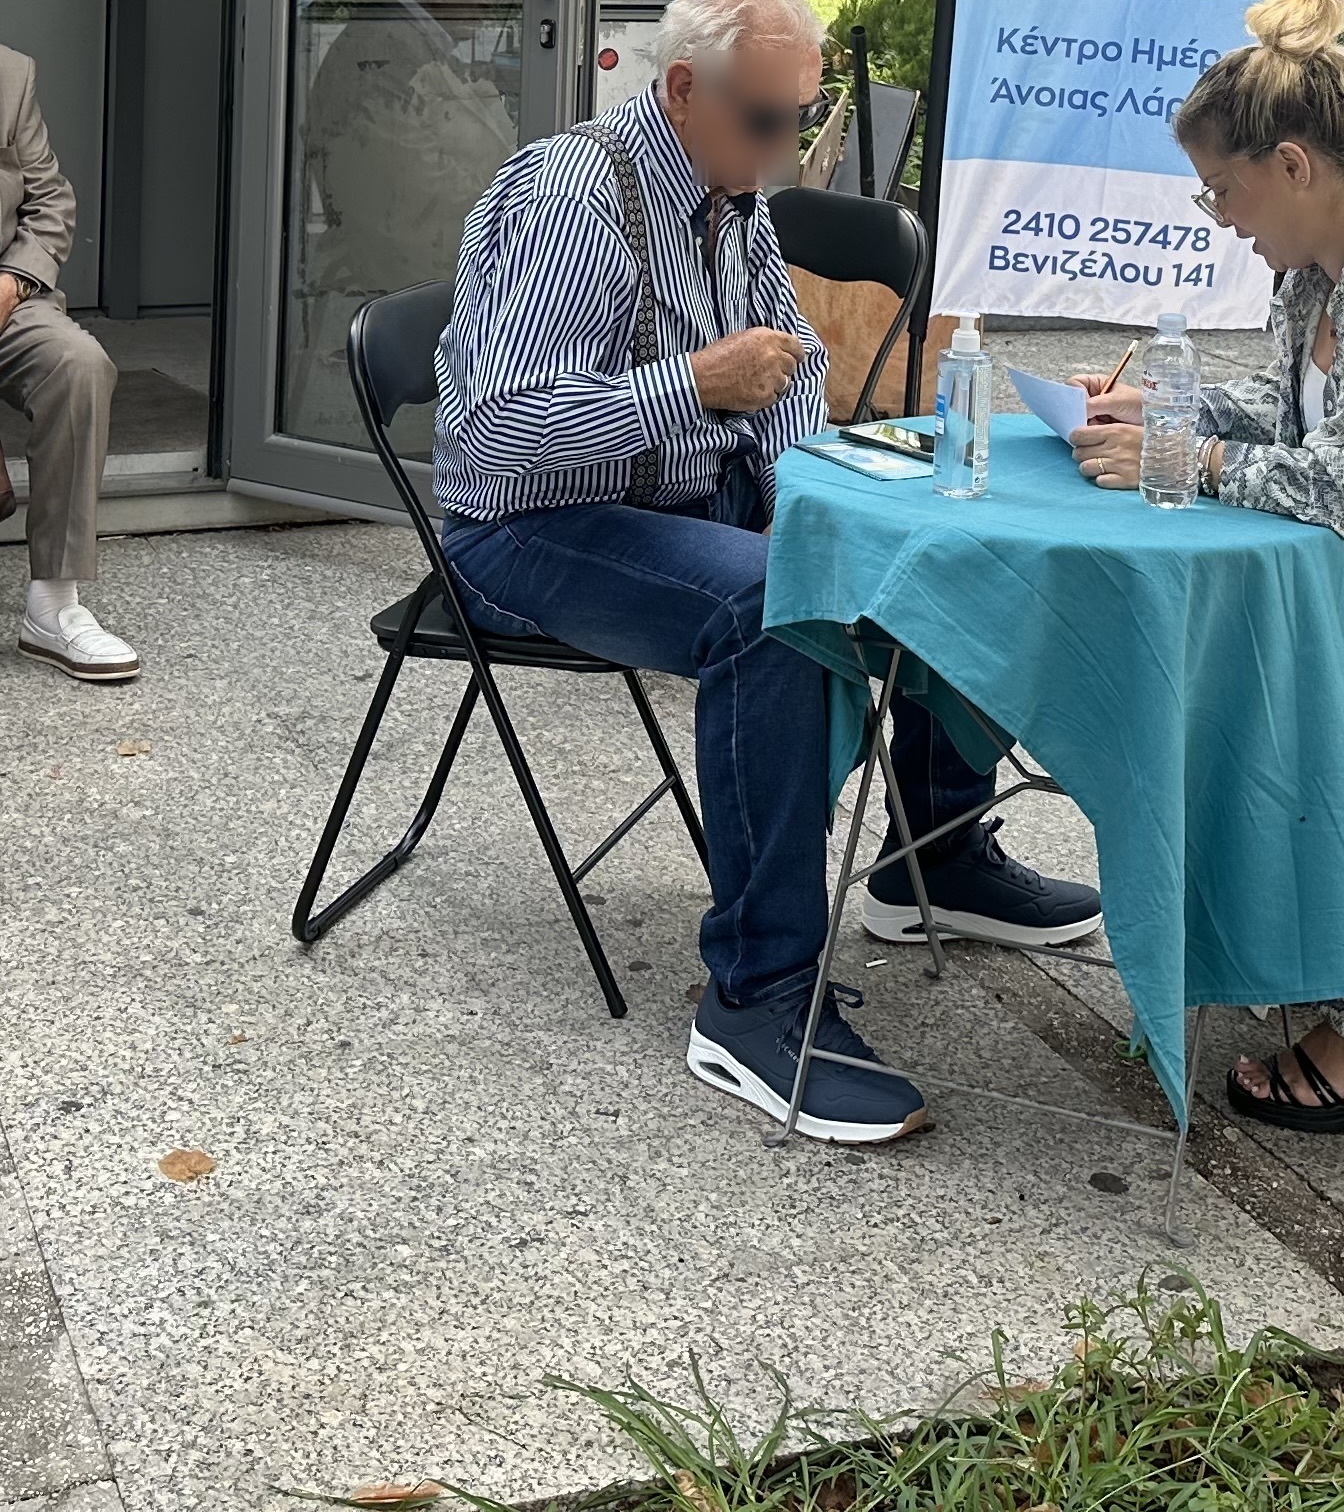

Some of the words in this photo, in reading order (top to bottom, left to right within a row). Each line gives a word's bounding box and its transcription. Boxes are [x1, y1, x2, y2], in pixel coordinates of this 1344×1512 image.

[996, 25, 1123, 65] Κέντρο
[990, 77, 1109, 118] Άνοιας
[1001, 208, 1081, 240] 2410
[1088, 216, 1212, 253] 257478
[988, 245, 1163, 287] Βενιζέλου
[1172, 262, 1216, 288] 141
